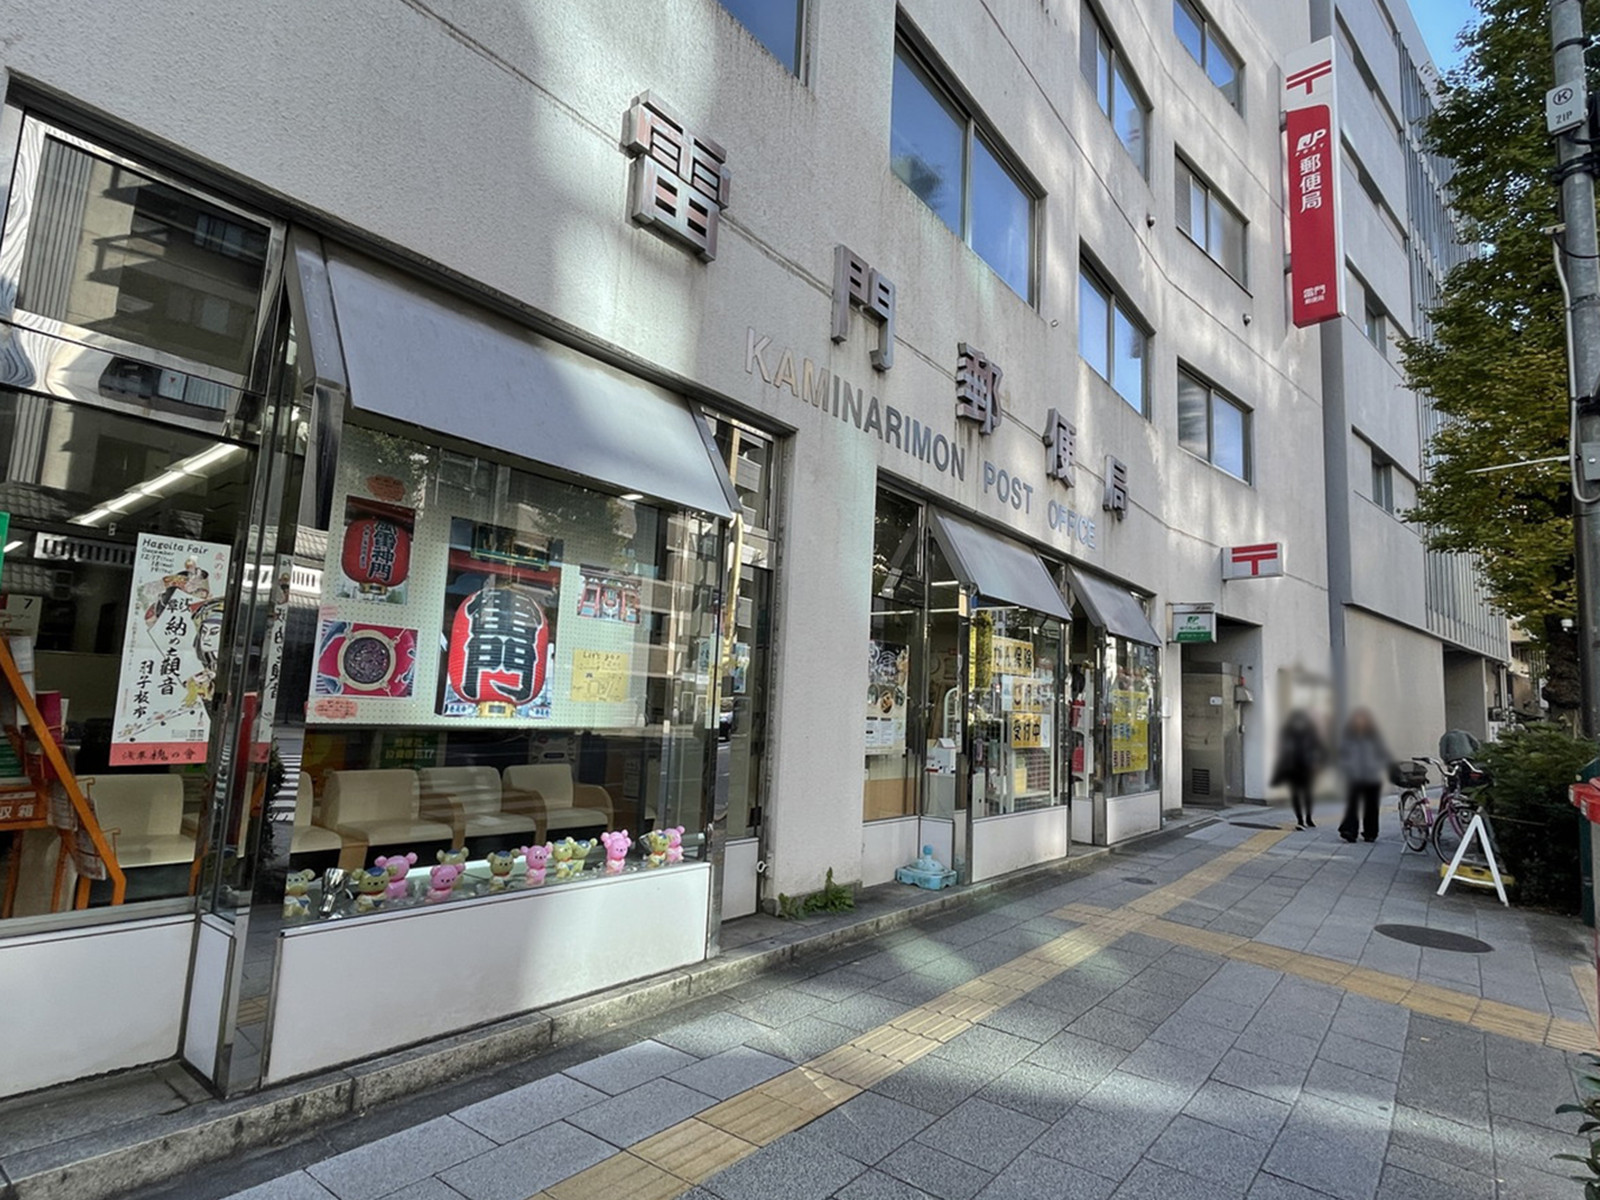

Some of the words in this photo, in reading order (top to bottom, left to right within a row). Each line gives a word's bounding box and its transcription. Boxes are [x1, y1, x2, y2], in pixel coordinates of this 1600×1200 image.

[1555, 110, 1573, 124] ZIP
[1299, 153, 1322, 214] 郵便局
[745, 327, 965, 482] KAMINARIMON
[983, 461, 1034, 514] POST
[1048, 500, 1097, 550] OFFICE
[142, 538, 183, 552] Hagoita
[187, 544, 209, 554] Fair
[24, 598, 33, 609] 7
